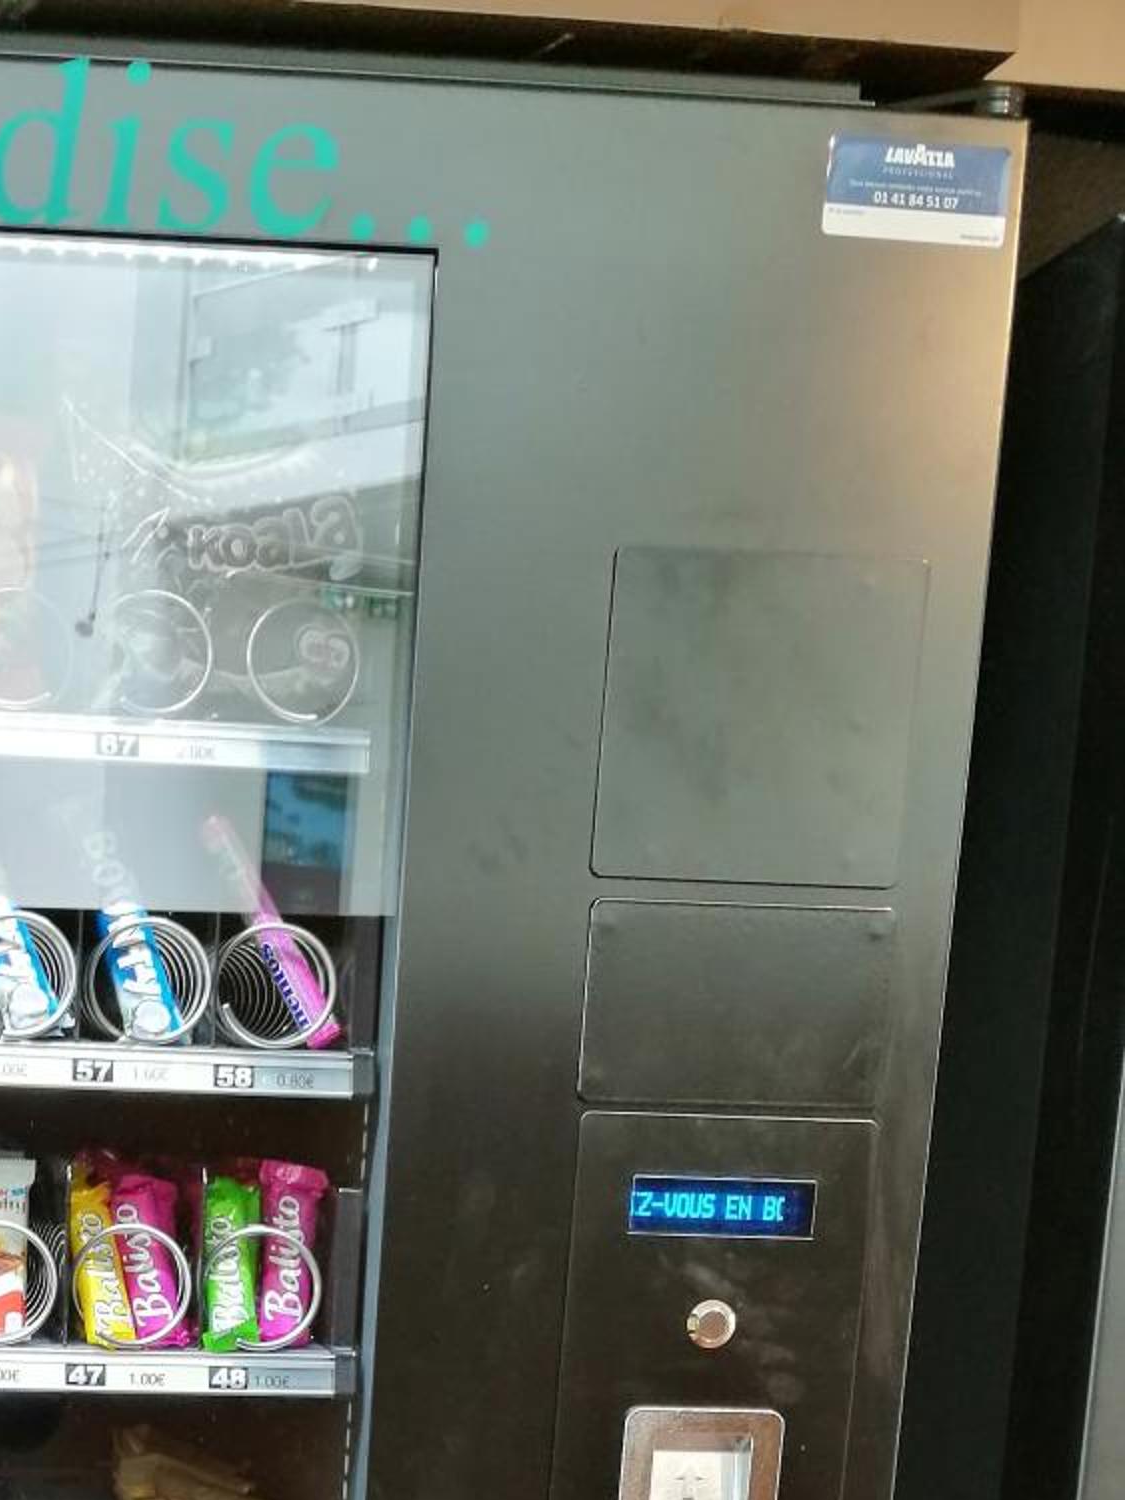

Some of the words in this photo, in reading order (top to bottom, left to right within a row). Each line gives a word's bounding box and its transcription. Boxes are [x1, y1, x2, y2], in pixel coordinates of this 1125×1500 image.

[885, 144, 955, 168] LAVAZZA
[874, 191, 888, 205] 01
[890, 193, 905, 206] 41
[909, 194, 924, 208] 84
[926, 195, 940, 209] 51
[943, 196, 958, 210] 07
[98, 734, 139, 757] 67
[74, 1060, 112, 1082] 57
[216, 1065, 253, 1088] 58
[725, 1195, 752, 1221] EN
[68, 1365, 105, 1386] 47
[210, 1368, 246, 1390] 48
